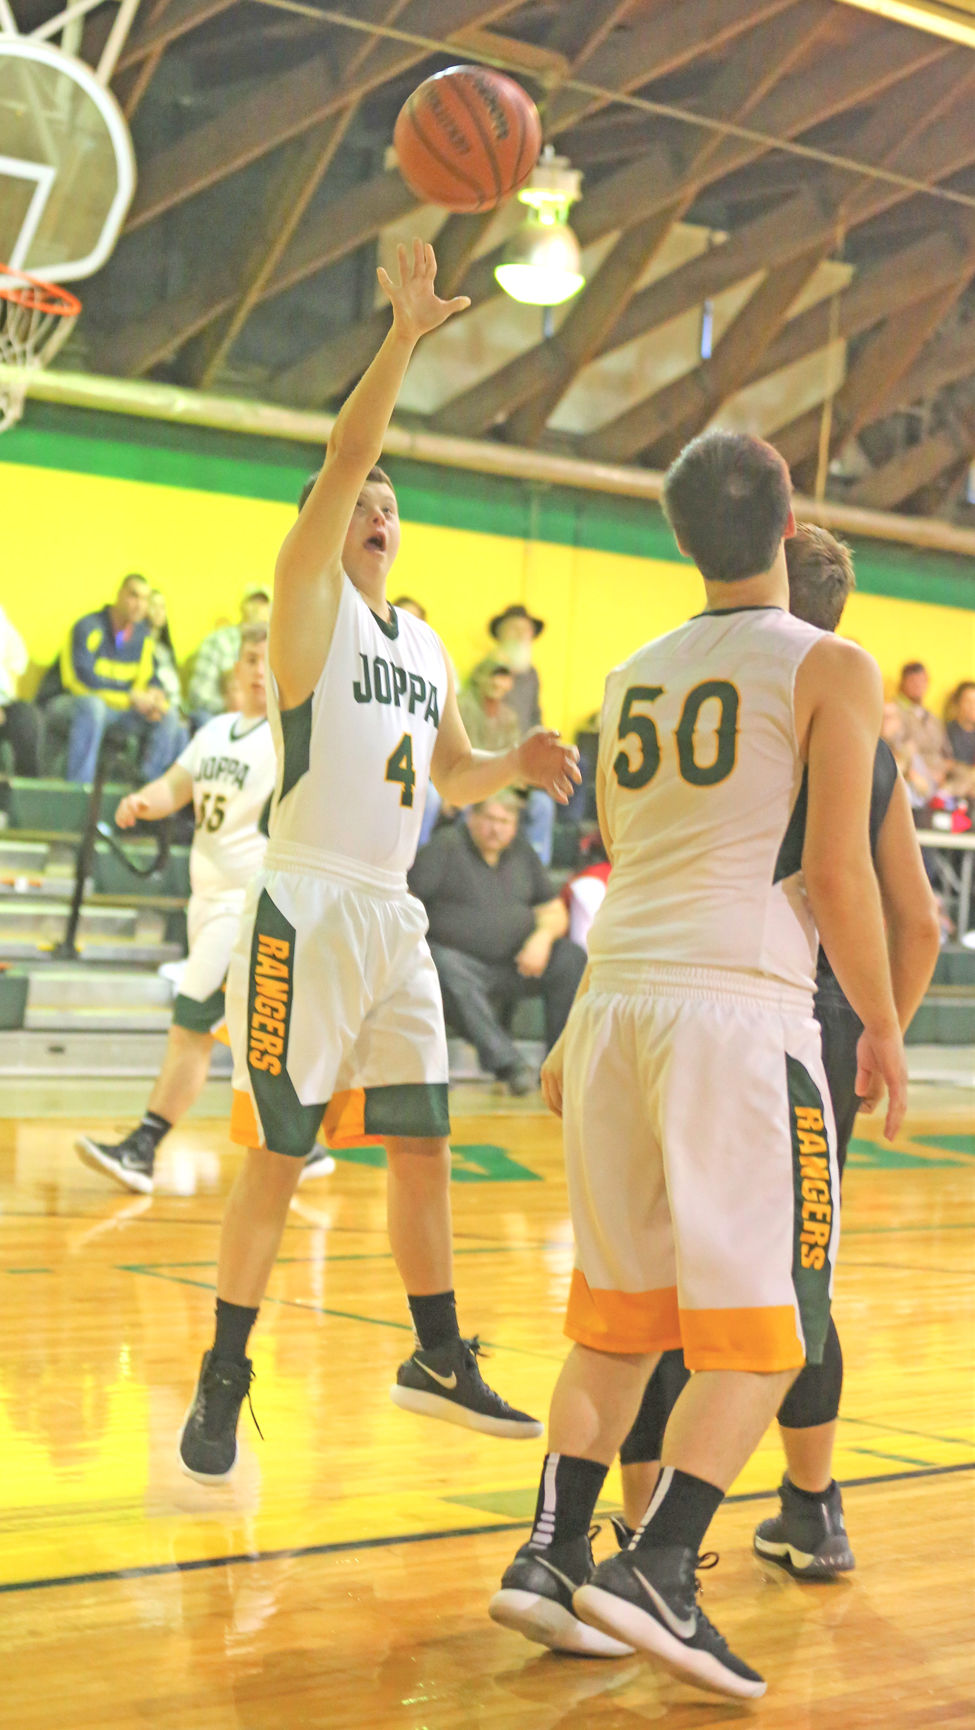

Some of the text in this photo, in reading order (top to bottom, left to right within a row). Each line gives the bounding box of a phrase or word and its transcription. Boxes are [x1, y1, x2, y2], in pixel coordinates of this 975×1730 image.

[353, 653, 439, 729] JOPPA
[613, 677, 741, 792] 50
[194, 756, 250, 791] JOPPA
[384, 731, 416, 809] 4
[249, 933, 290, 1077] RANGERS
[794, 1106, 832, 1271] RANGERS
